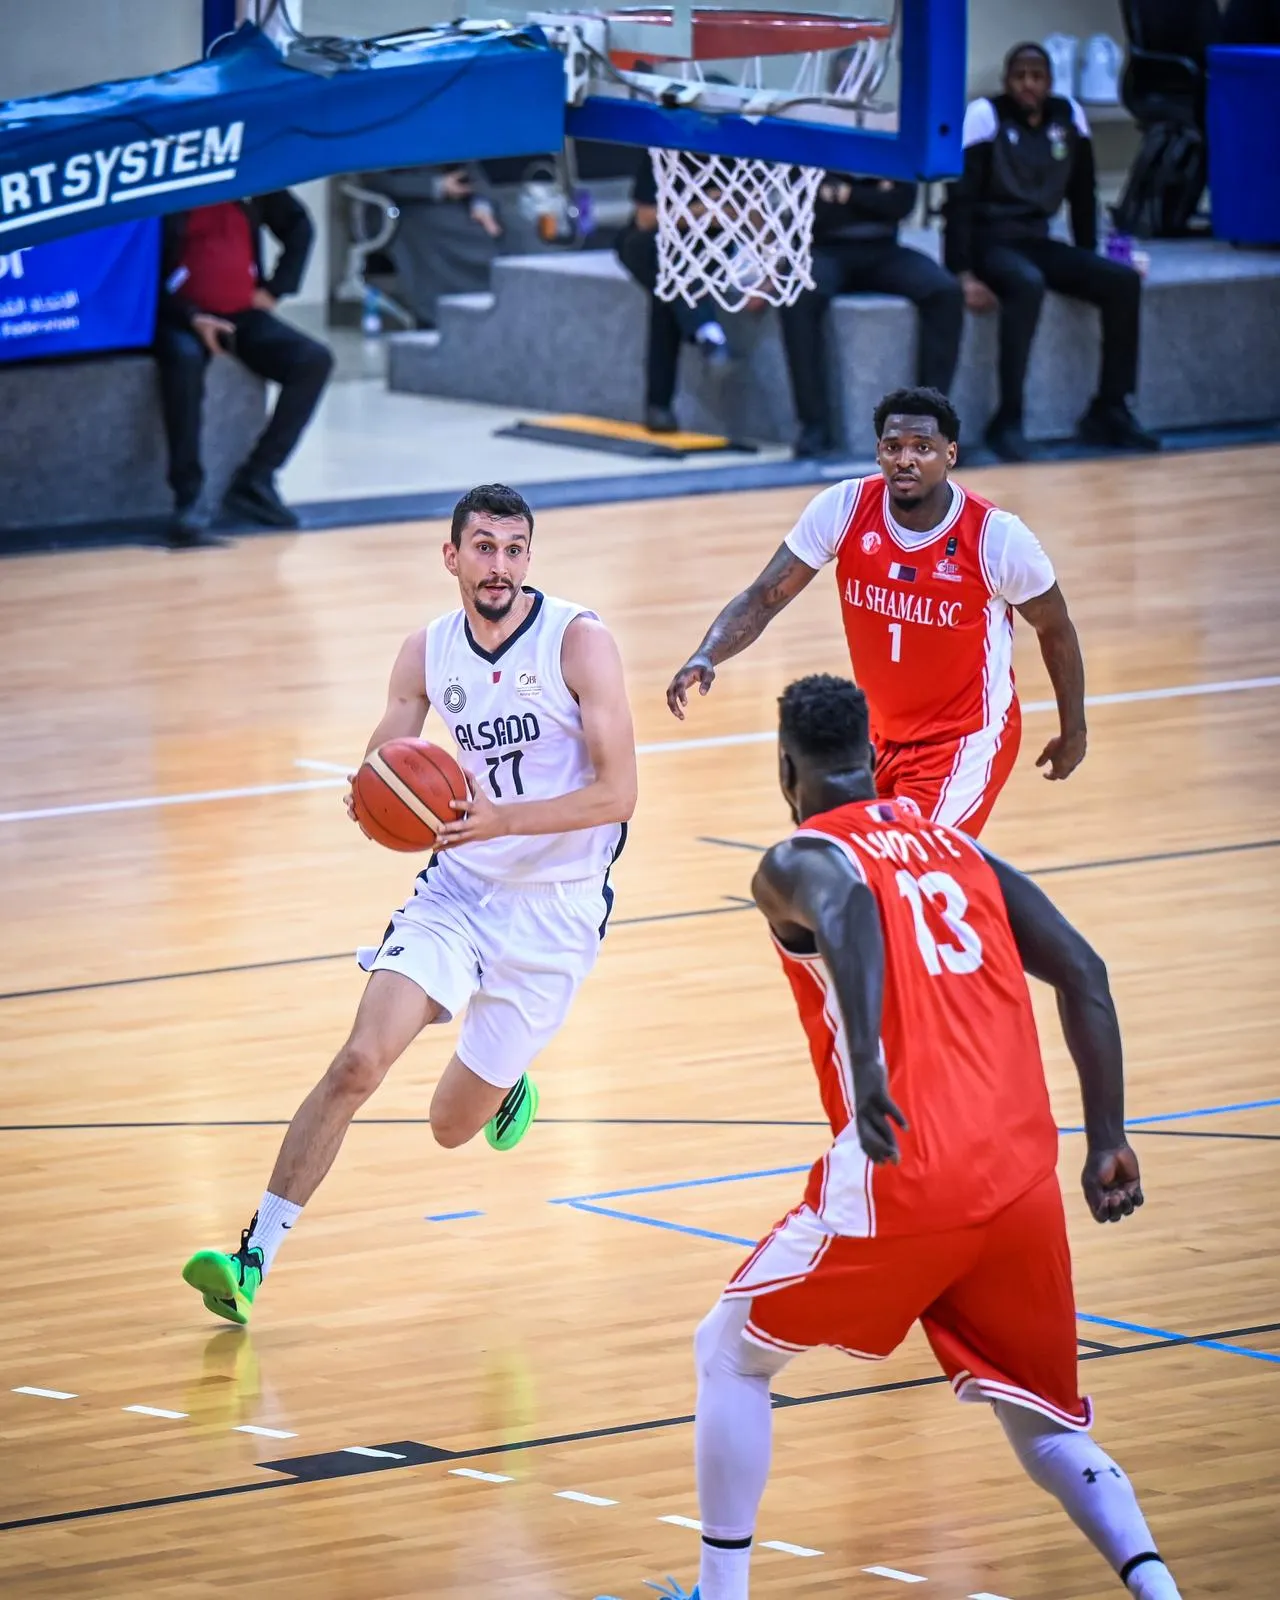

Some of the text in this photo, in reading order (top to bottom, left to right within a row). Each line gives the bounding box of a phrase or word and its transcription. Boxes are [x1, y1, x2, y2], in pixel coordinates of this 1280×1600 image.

[62, 121, 244, 206] SYSTEM
[844, 579, 962, 627] AL SHAMAL SC
[888, 622, 902, 663] 1
[455, 712, 541, 751] ALSADD
[485, 749, 525, 798] 77
[895, 869, 984, 976] 13
